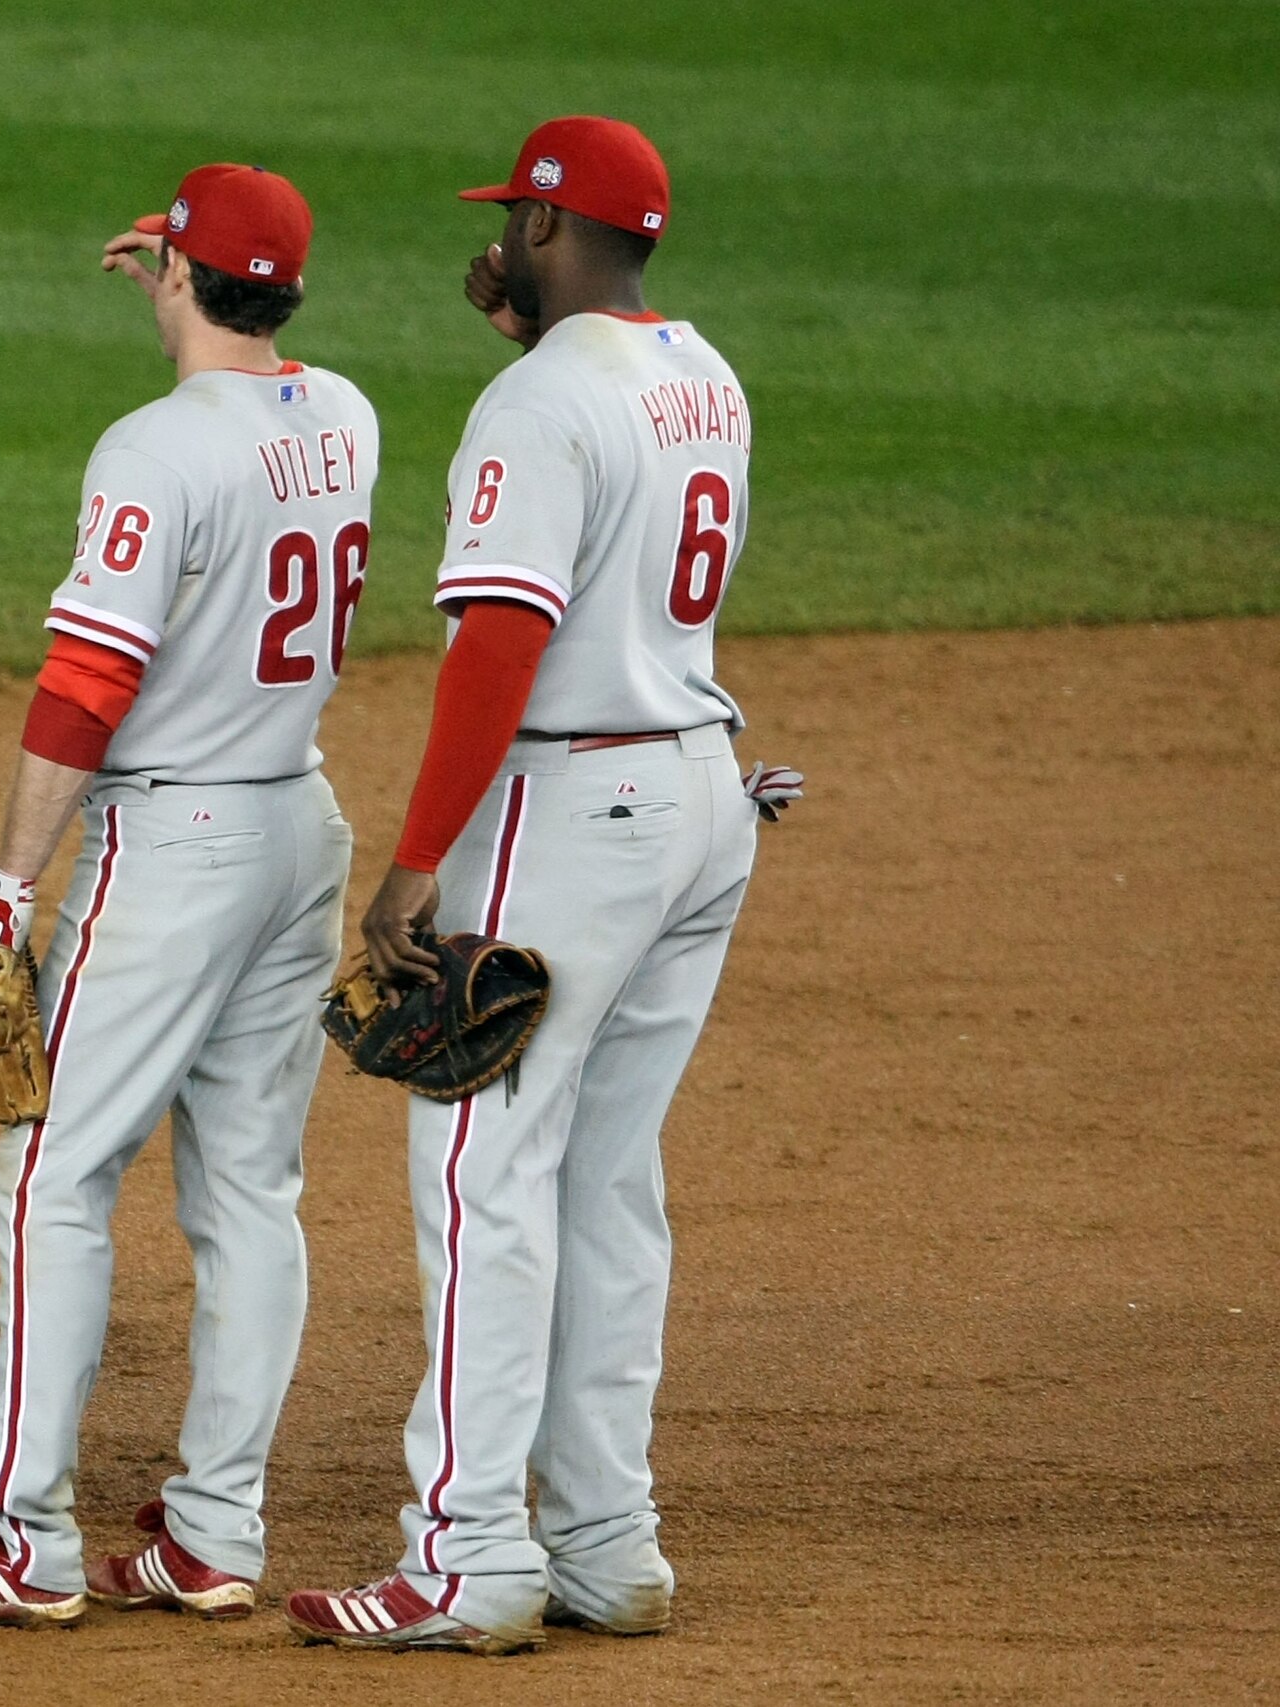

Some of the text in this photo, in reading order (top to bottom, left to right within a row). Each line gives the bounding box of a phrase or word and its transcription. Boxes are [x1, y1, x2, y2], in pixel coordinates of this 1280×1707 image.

[257, 426, 357, 503] UTLEY
[467, 456, 507, 528] 6
[74, 491, 153, 576] 26
[665, 466, 731, 631] 6
[252, 518, 370, 689] 26
